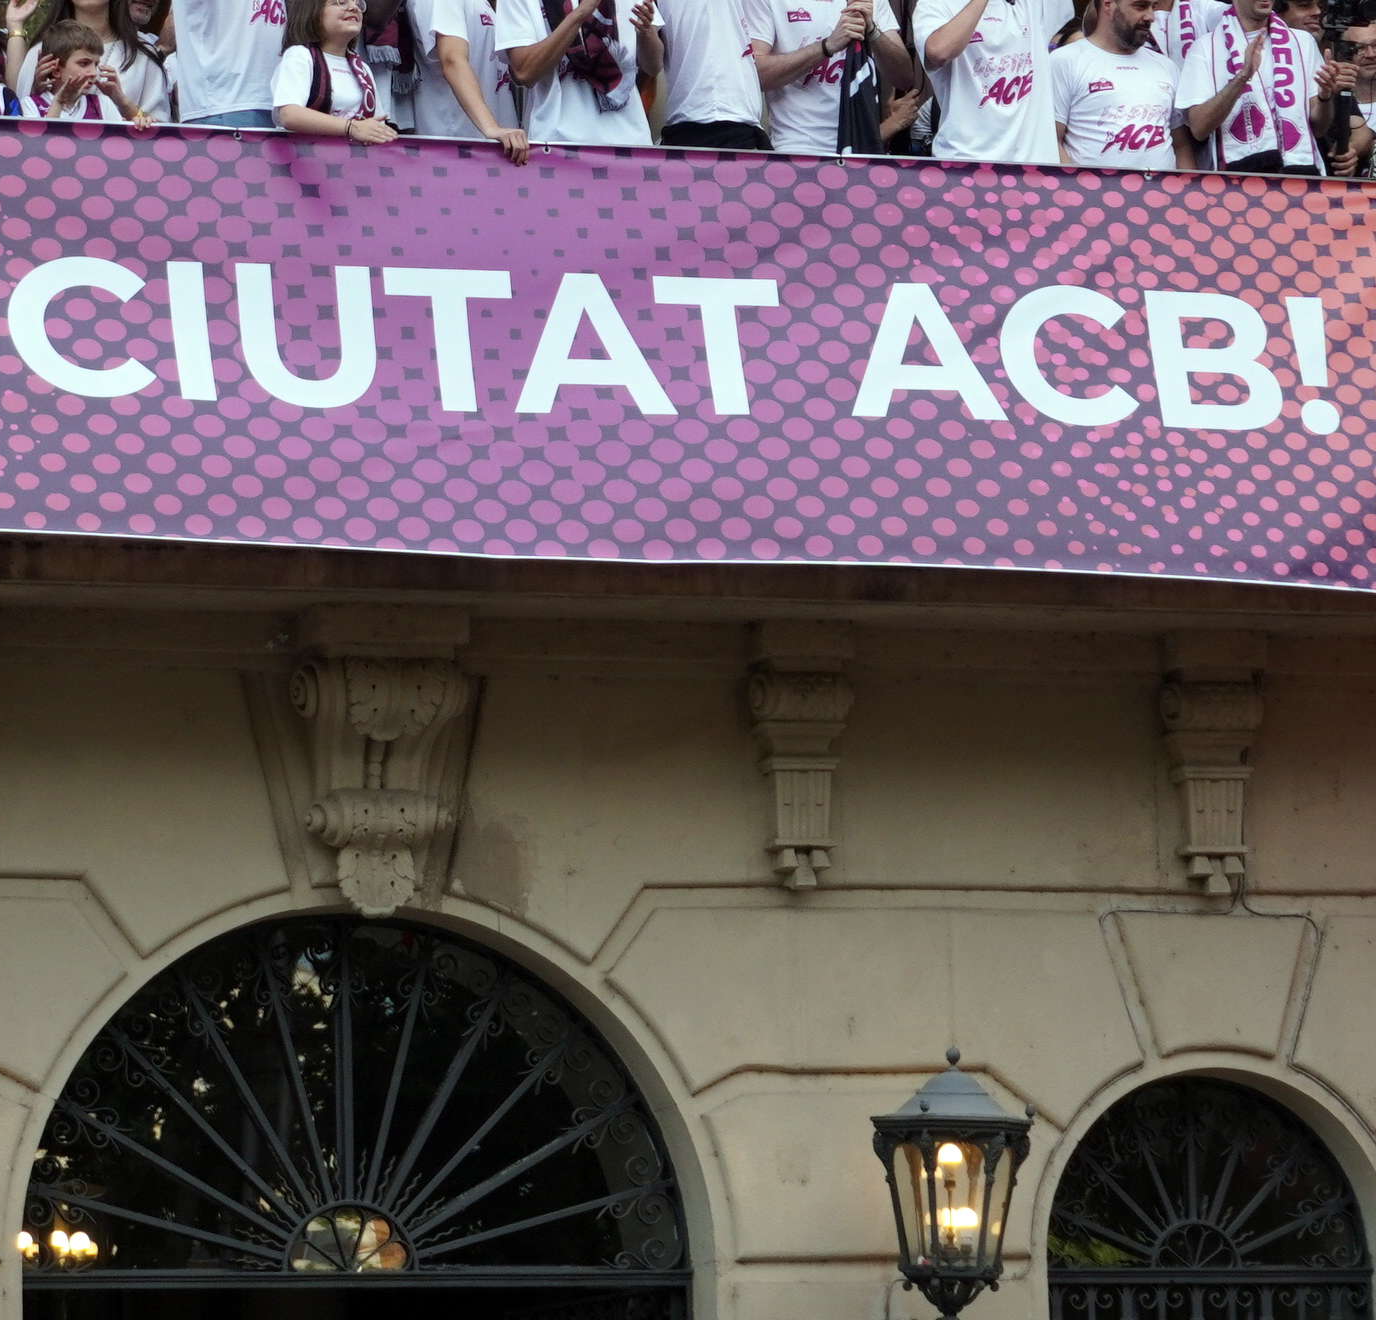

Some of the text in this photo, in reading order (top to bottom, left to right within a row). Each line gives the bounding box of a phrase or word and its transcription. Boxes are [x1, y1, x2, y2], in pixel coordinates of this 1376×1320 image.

[1100, 123, 1166, 156] ACB
[7, 256, 780, 416] CIUTAT
[851, 282, 1341, 436] ACB!
